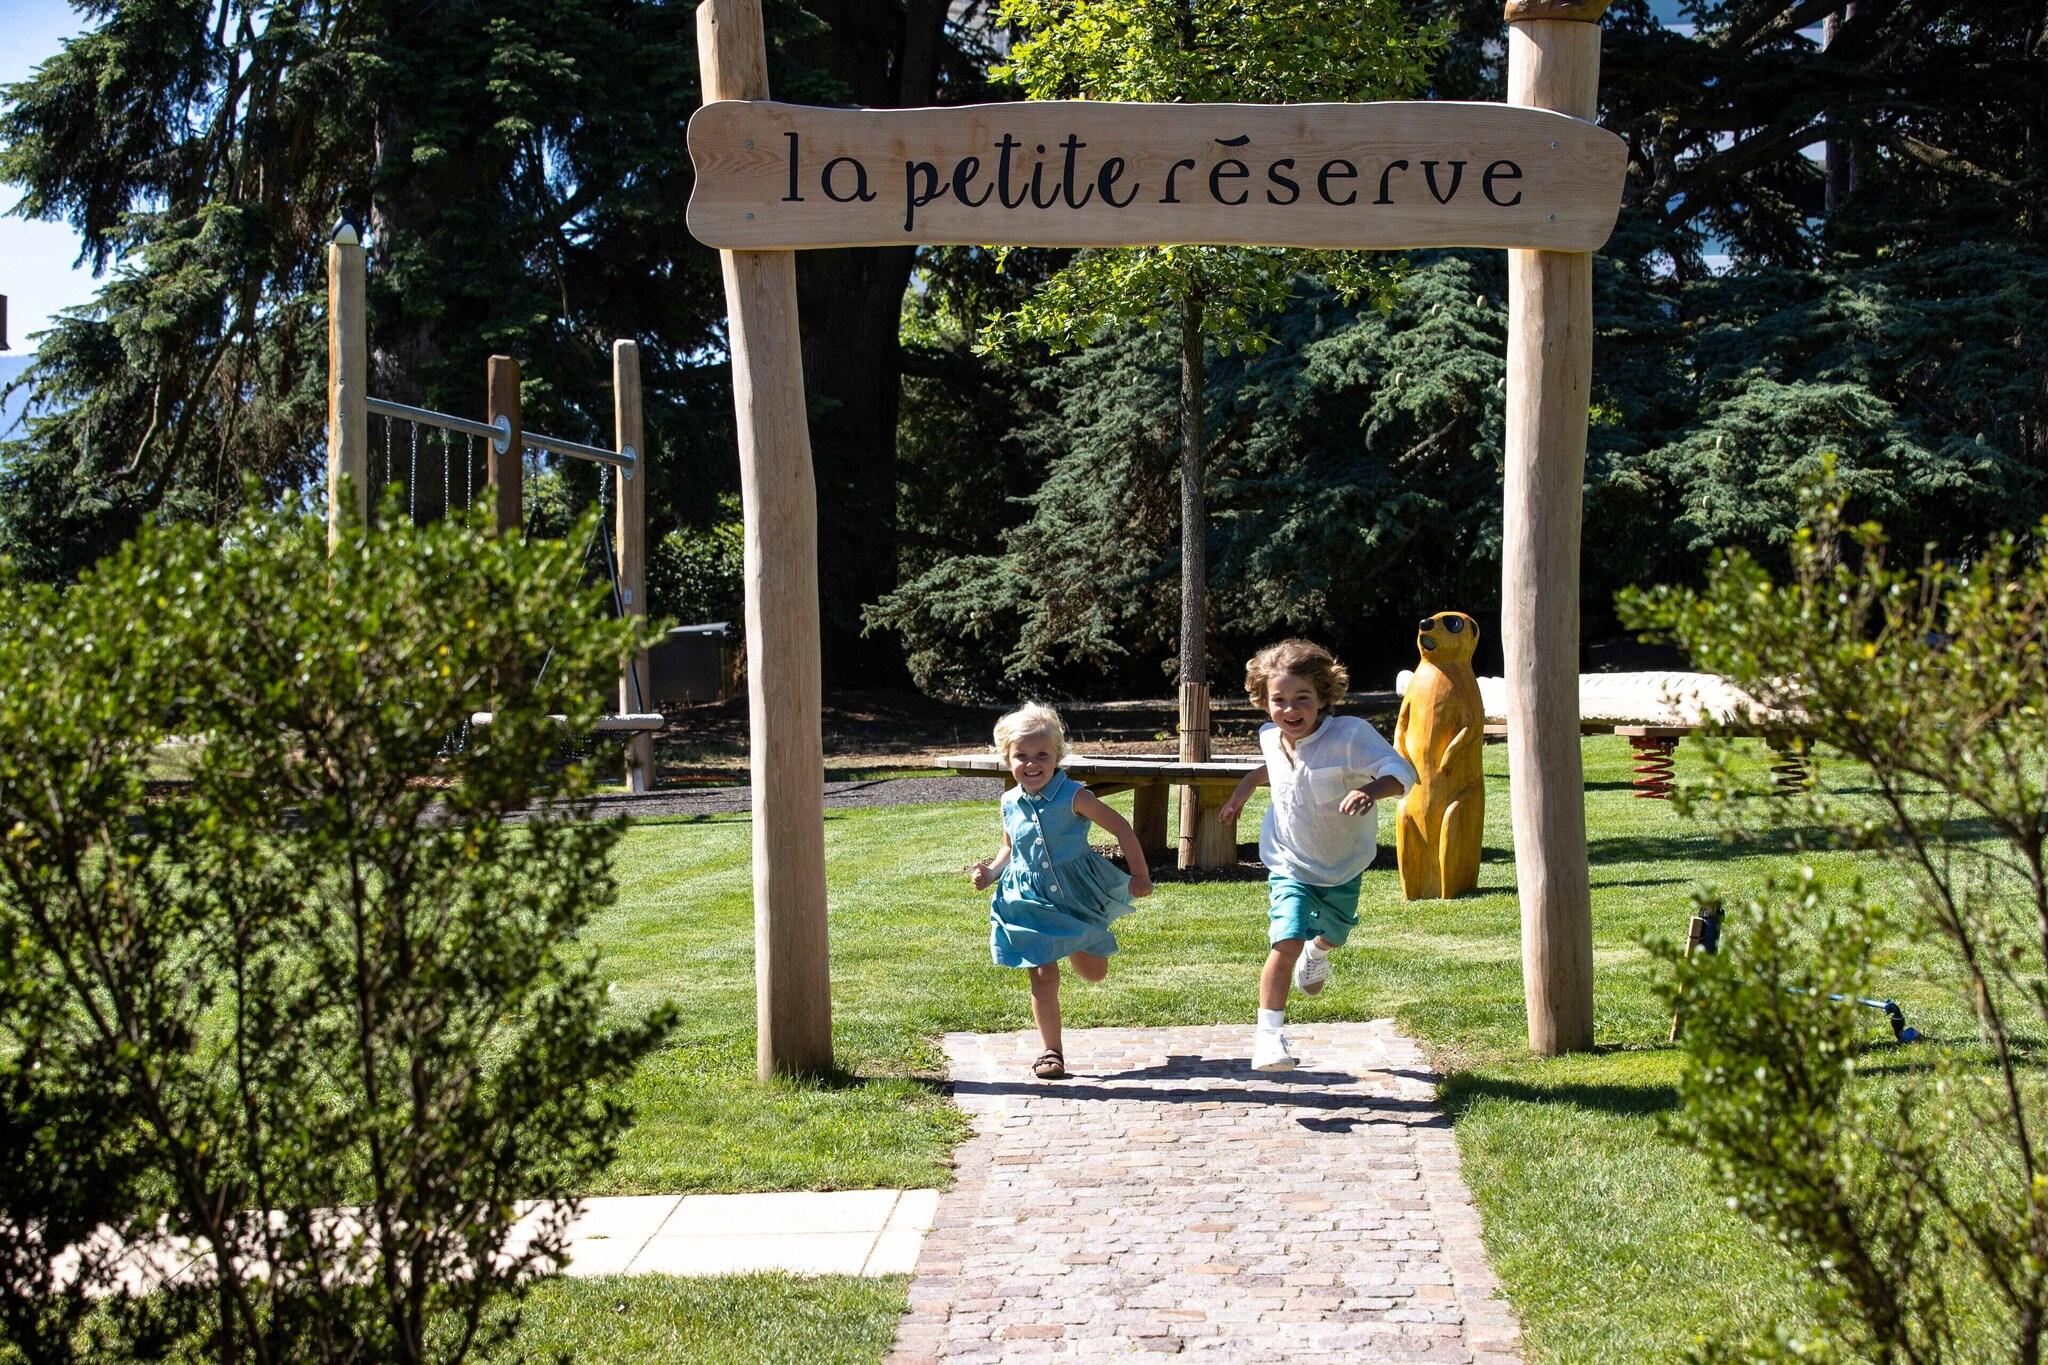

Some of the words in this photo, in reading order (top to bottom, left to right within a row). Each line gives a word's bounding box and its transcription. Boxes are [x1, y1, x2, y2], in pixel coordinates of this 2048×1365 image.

[782, 131, 877, 203] la
[903, 132, 1140, 232] petite
[1158, 134, 1523, 207] réserve
